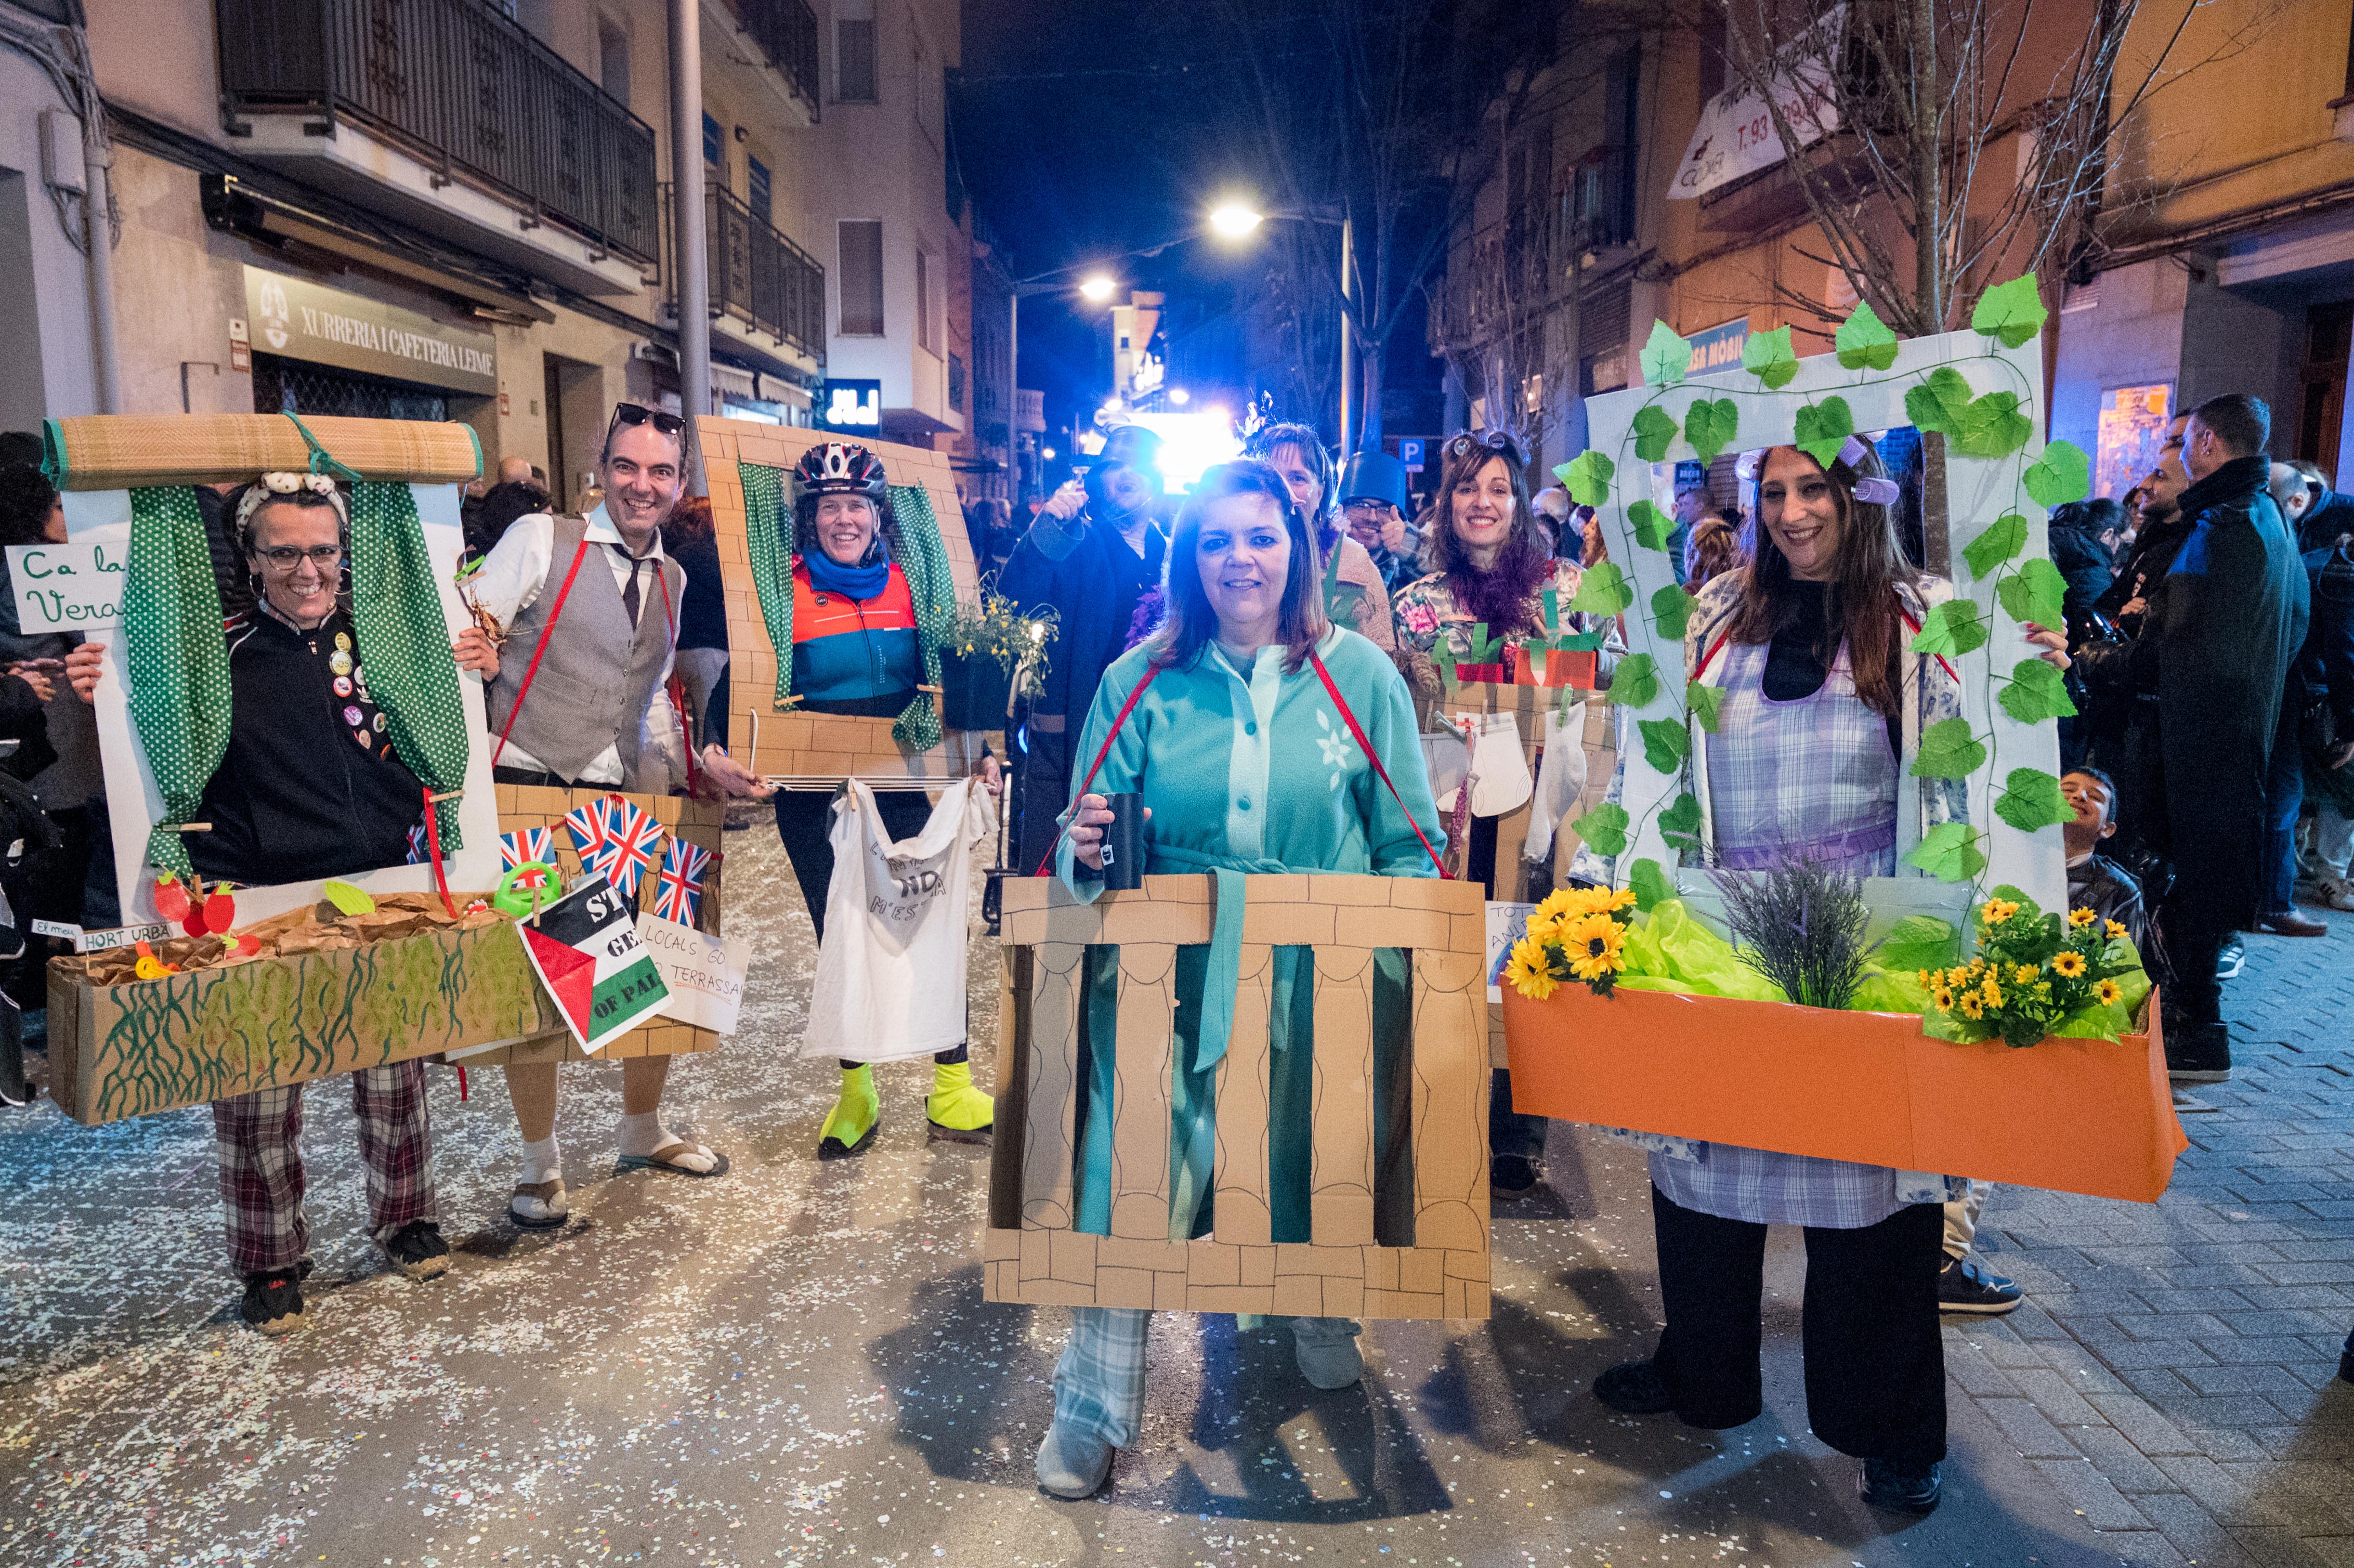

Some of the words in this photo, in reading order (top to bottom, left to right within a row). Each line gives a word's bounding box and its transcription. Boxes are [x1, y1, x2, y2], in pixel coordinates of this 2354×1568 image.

[301, 306, 380, 350] XURRERIA
[388, 329, 458, 368] CAFETERIA
[1405, 443, 1419, 461] P
[23, 552, 76, 579] Ca
[94, 545, 125, 572] la
[27, 590, 124, 623] Vera
[1490, 906, 1532, 918] TOT
[37, 922, 48, 934] El
[51, 926, 75, 936] meu
[85, 931, 124, 949] HORT
[607, 929, 643, 957] GE
[646, 925, 697, 955] LOCALS
[707, 949, 725, 964] GO
[594, 995, 618, 1018] OF
